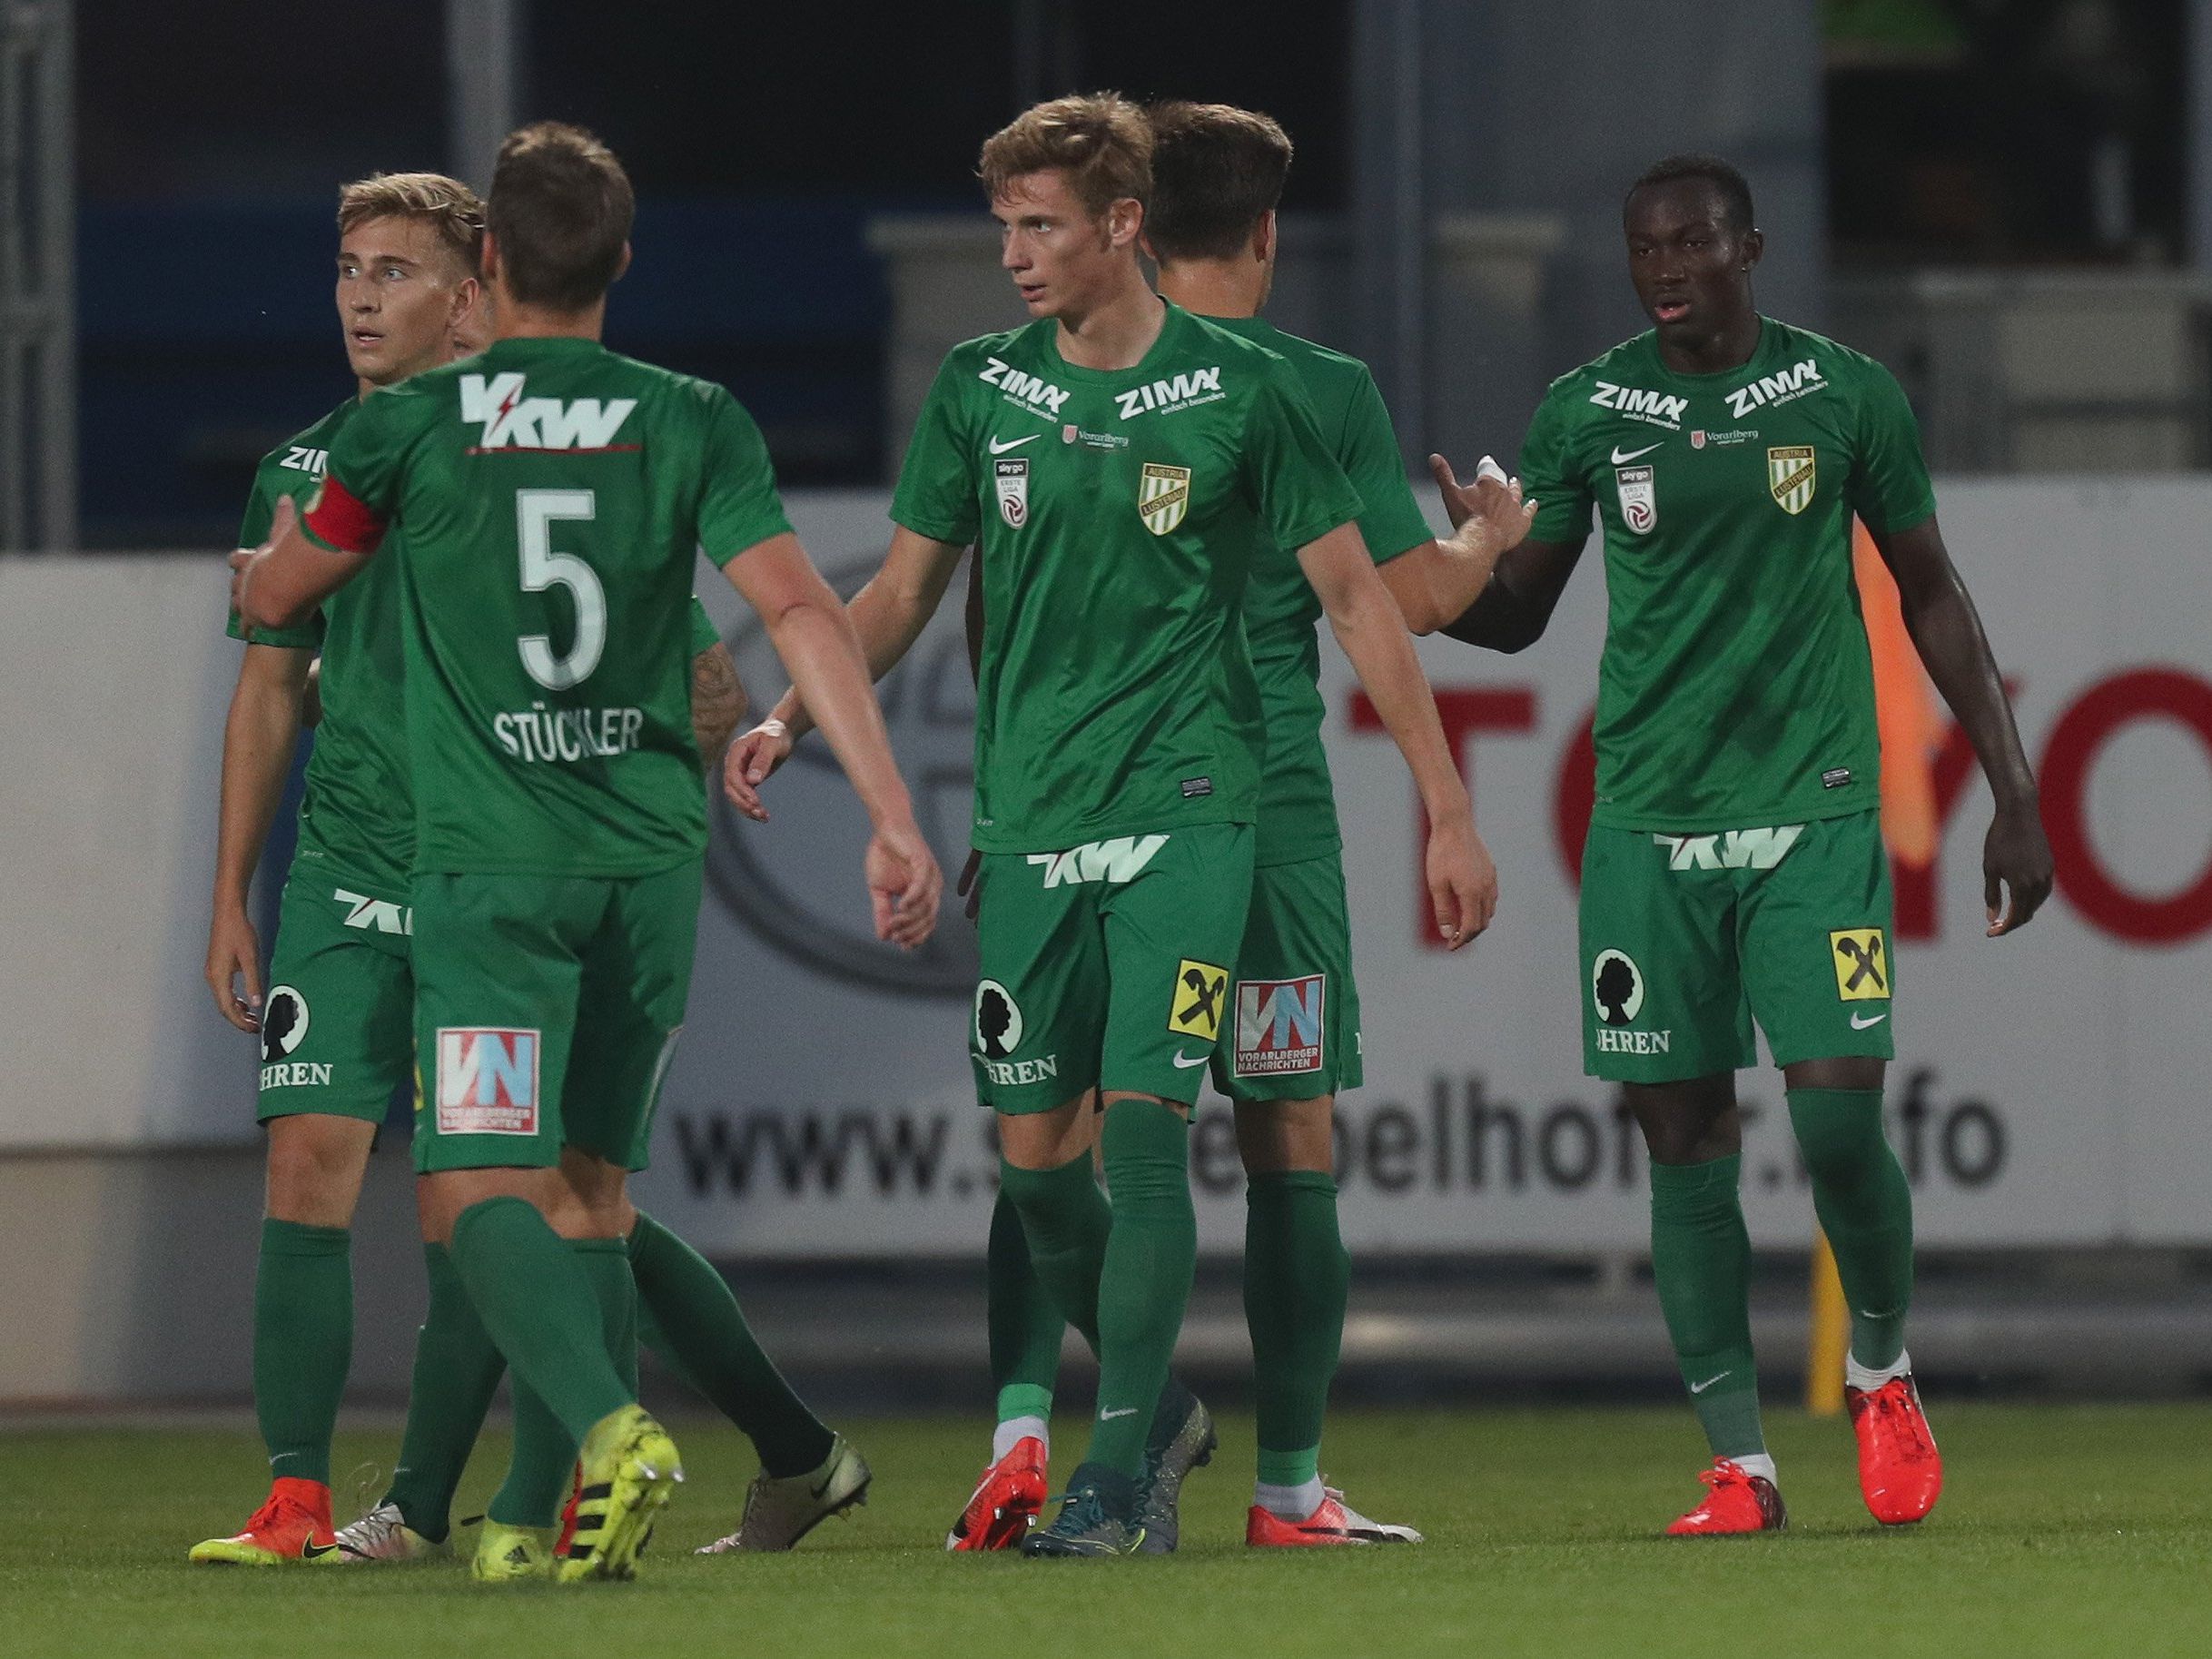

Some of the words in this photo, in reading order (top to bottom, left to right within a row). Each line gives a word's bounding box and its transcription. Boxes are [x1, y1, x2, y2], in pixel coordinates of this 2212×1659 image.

[1707, 430, 1759, 440] Vorarlberg
[516, 488, 608, 692] 5
[494, 701, 644, 764] STÜCKLER
[1238, 1047, 1318, 1062] VORARLBERGER
[1238, 1058, 1311, 1072] NACHRICHTEN
